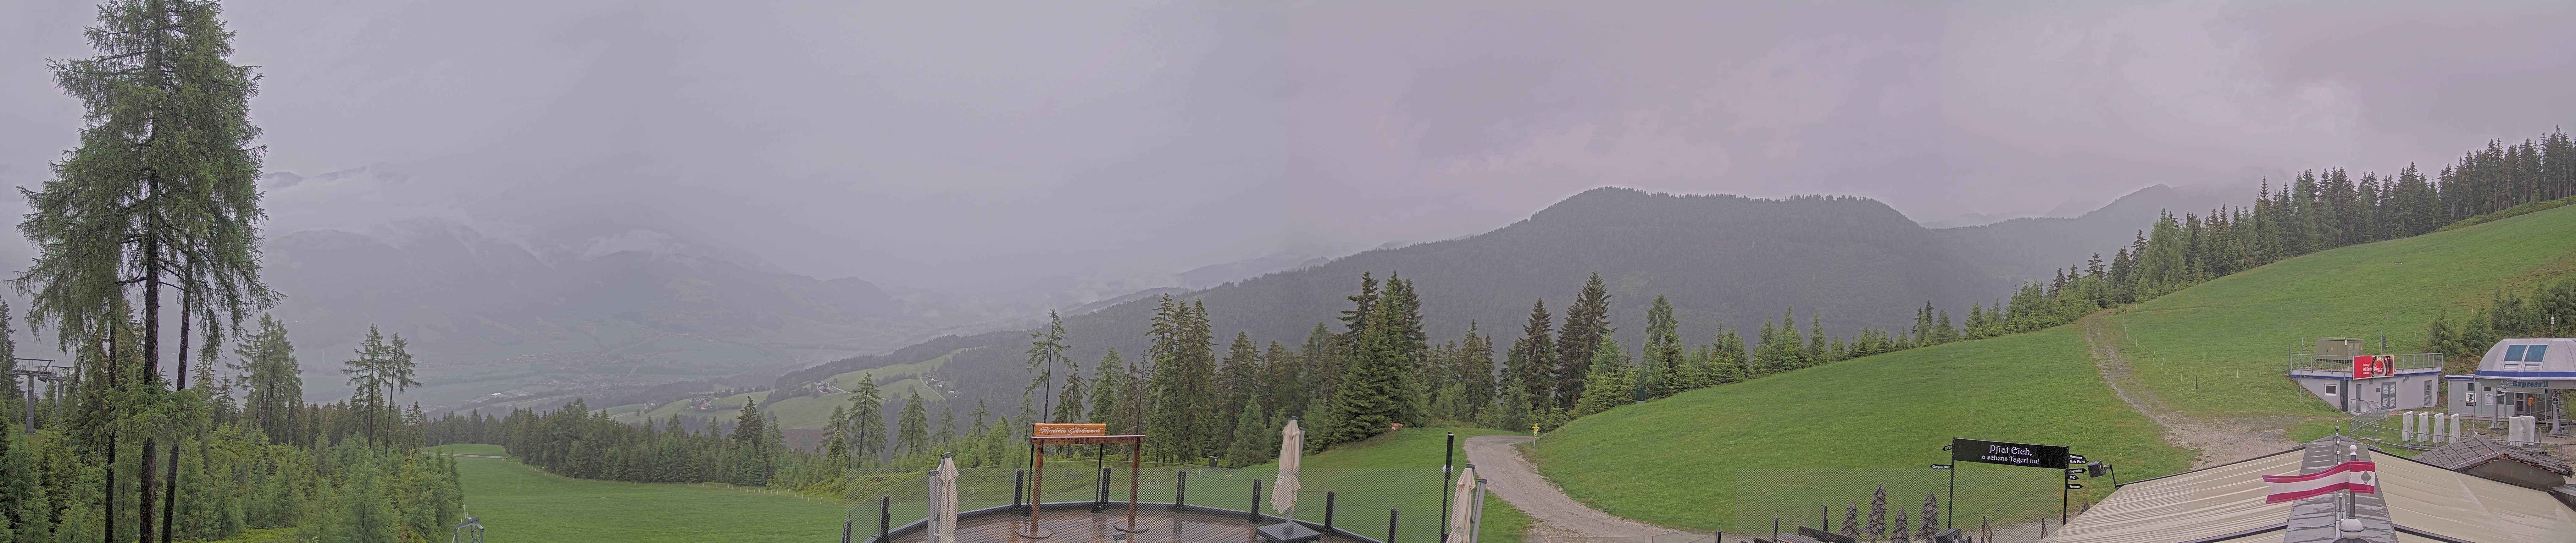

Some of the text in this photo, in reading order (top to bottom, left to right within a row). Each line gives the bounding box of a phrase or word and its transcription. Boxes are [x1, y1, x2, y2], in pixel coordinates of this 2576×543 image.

[2512, 380, 2542, 388] Express
[1989, 445, 2032, 456] Pfiat Eich,
